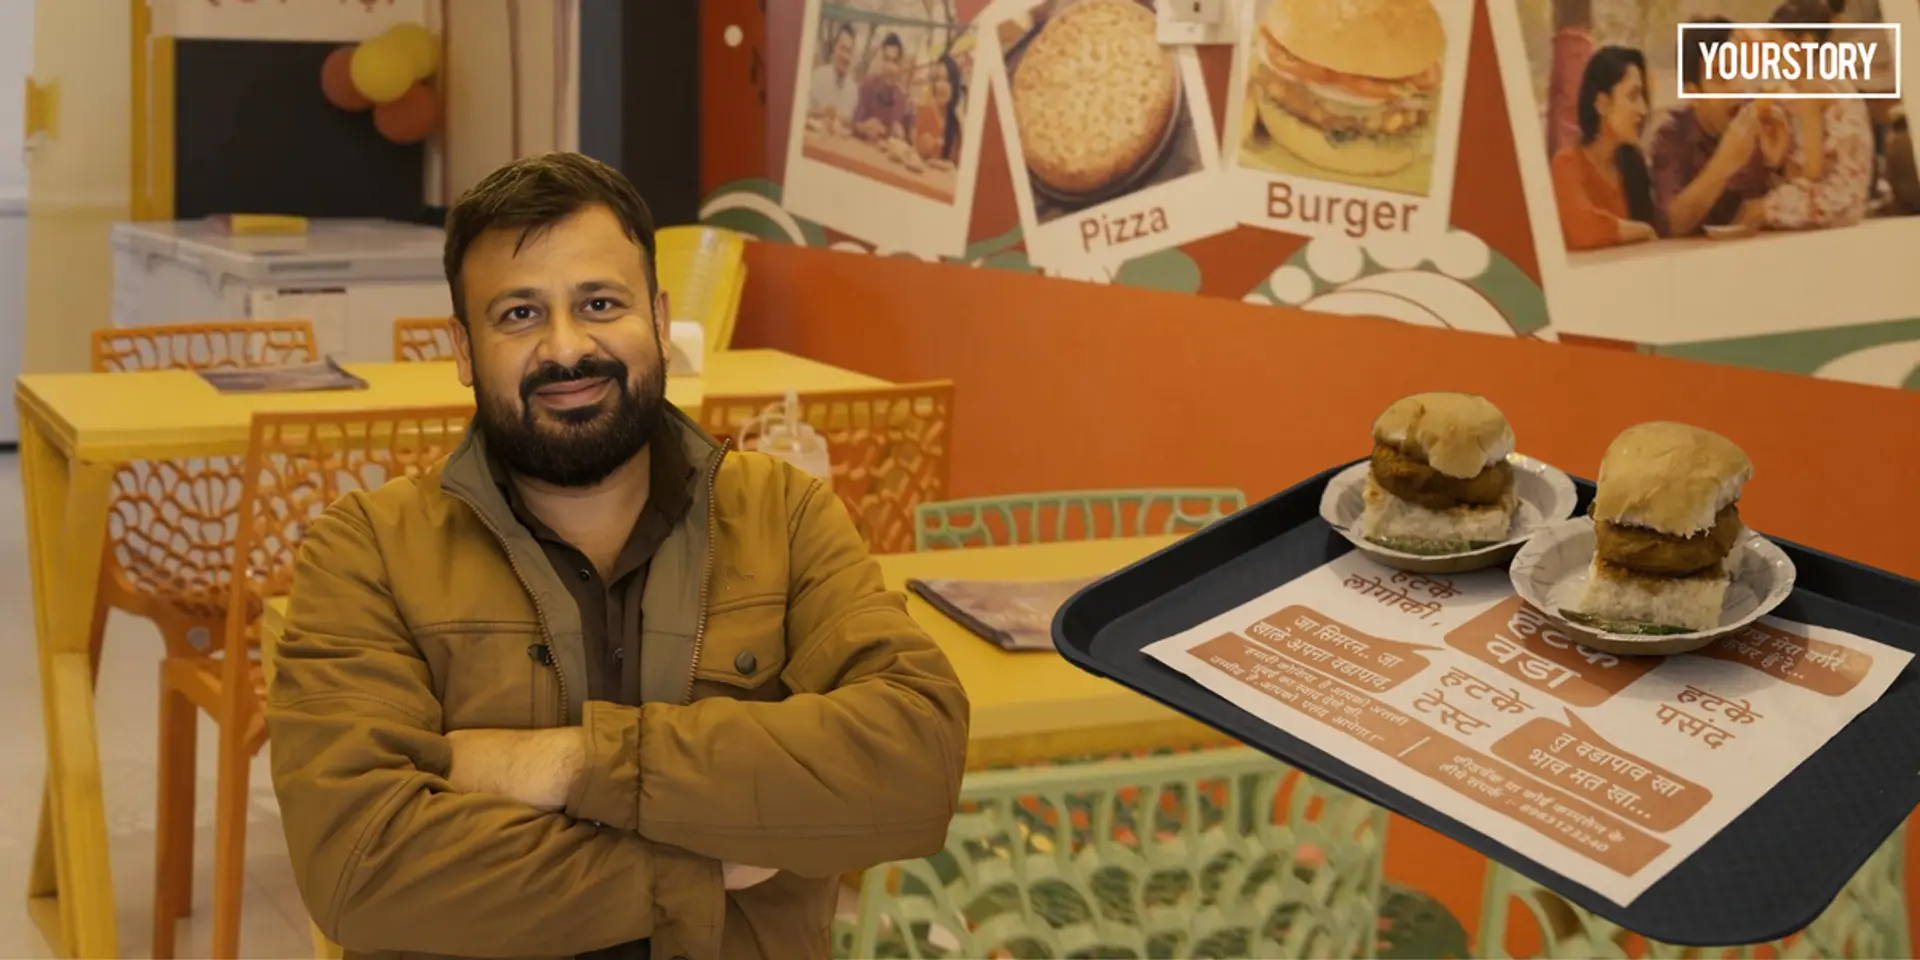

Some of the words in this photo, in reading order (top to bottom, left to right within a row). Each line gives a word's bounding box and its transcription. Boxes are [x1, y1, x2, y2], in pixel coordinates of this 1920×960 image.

[1079, 206, 1170, 254] Pizza
[1266, 181, 1418, 238] Burger
[1252, 621, 1292, 642] खाले
[1286, 638, 1334, 662] अपना
[1294, 614, 1322, 630] जा
[1377, 652, 1404, 668] जा
[1486, 633, 1582, 688] वडा
[1507, 606, 1620, 668] हटक
[1771, 636, 1804, 655] मेरा
[1412, 688, 1492, 736] टेस्ट
[1440, 666, 1536, 715] हटके
[1655, 704, 1736, 750] पसंद
[1528, 748, 1572, 775] भाव
[1569, 768, 1608, 792] मत
[1575, 740, 1652, 781] वडापाव
[1651, 774, 1685, 798] खा
